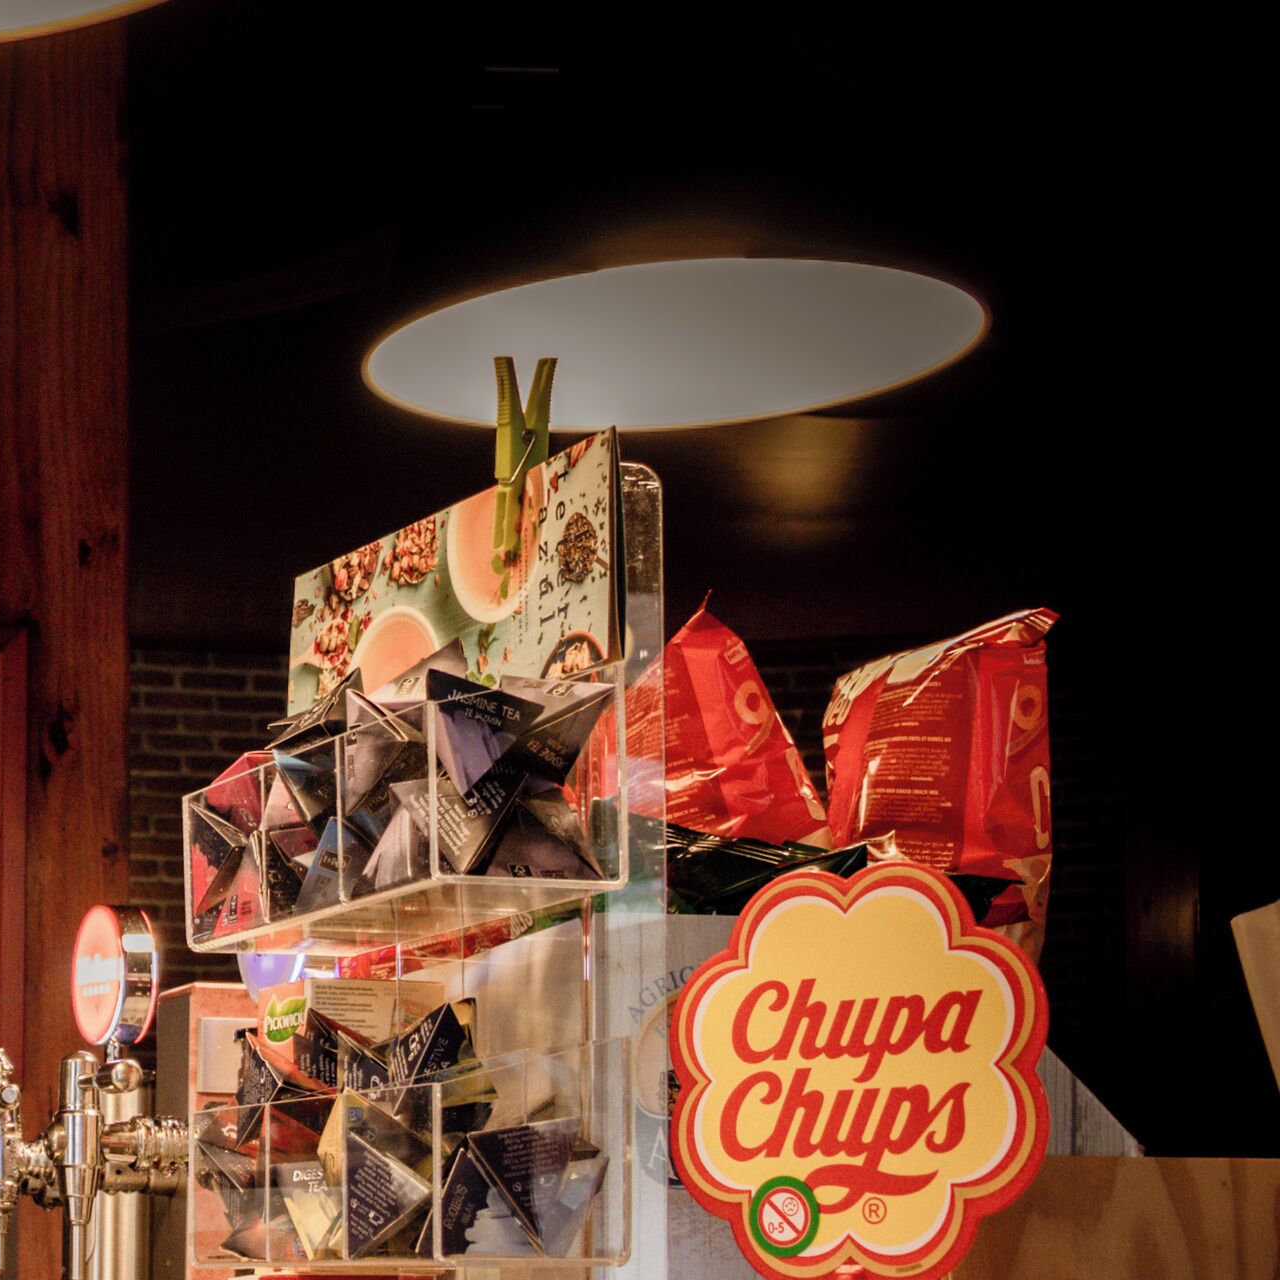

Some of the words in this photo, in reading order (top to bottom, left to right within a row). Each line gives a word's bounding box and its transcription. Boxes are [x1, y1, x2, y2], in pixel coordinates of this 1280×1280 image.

[501, 703, 522, 722] TEA
[731, 978, 983, 1084] Chupa
[719, 1067, 972, 1185] Chups
